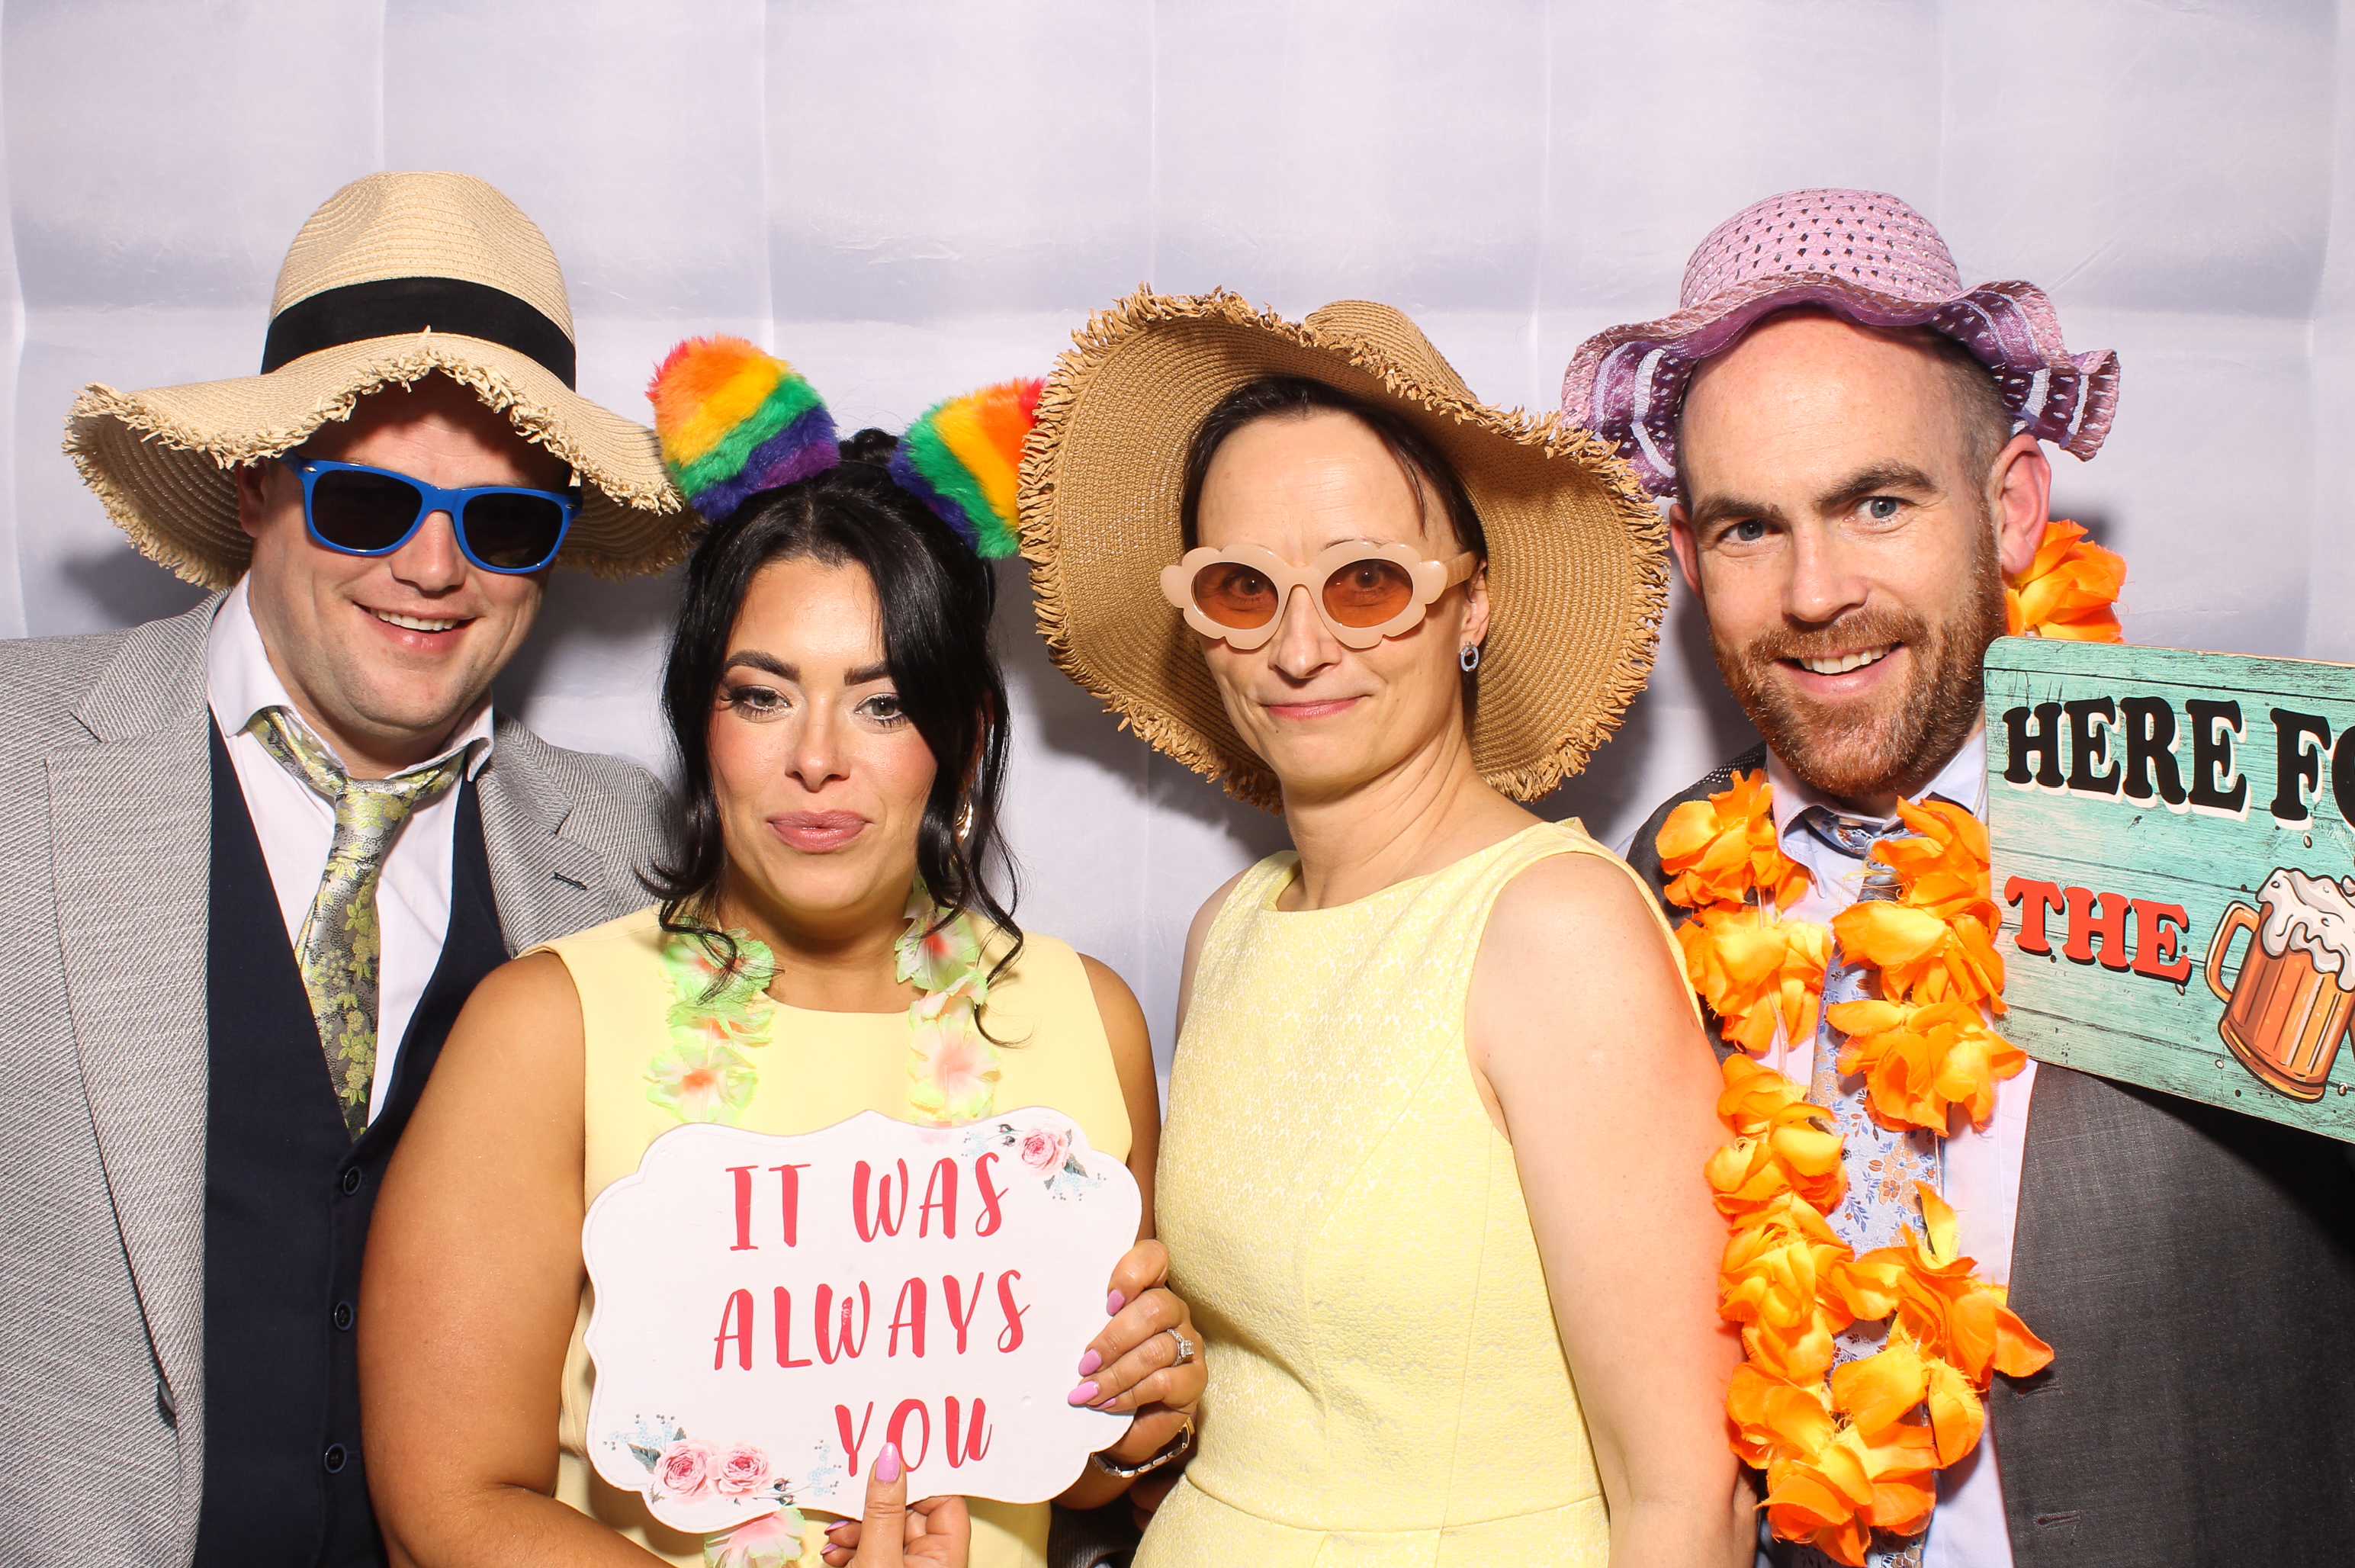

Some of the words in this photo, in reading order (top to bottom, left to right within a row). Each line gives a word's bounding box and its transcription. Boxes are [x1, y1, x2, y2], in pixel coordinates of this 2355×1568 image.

[2003, 696, 2248, 813] HERE
[2004, 876, 2191, 982] THE
[726, 1164, 811, 1251] IT
[853, 1152, 1008, 1242] WAS
[714, 1270, 1030, 1370] ALWAYS
[835, 1396, 992, 1477] YOU
